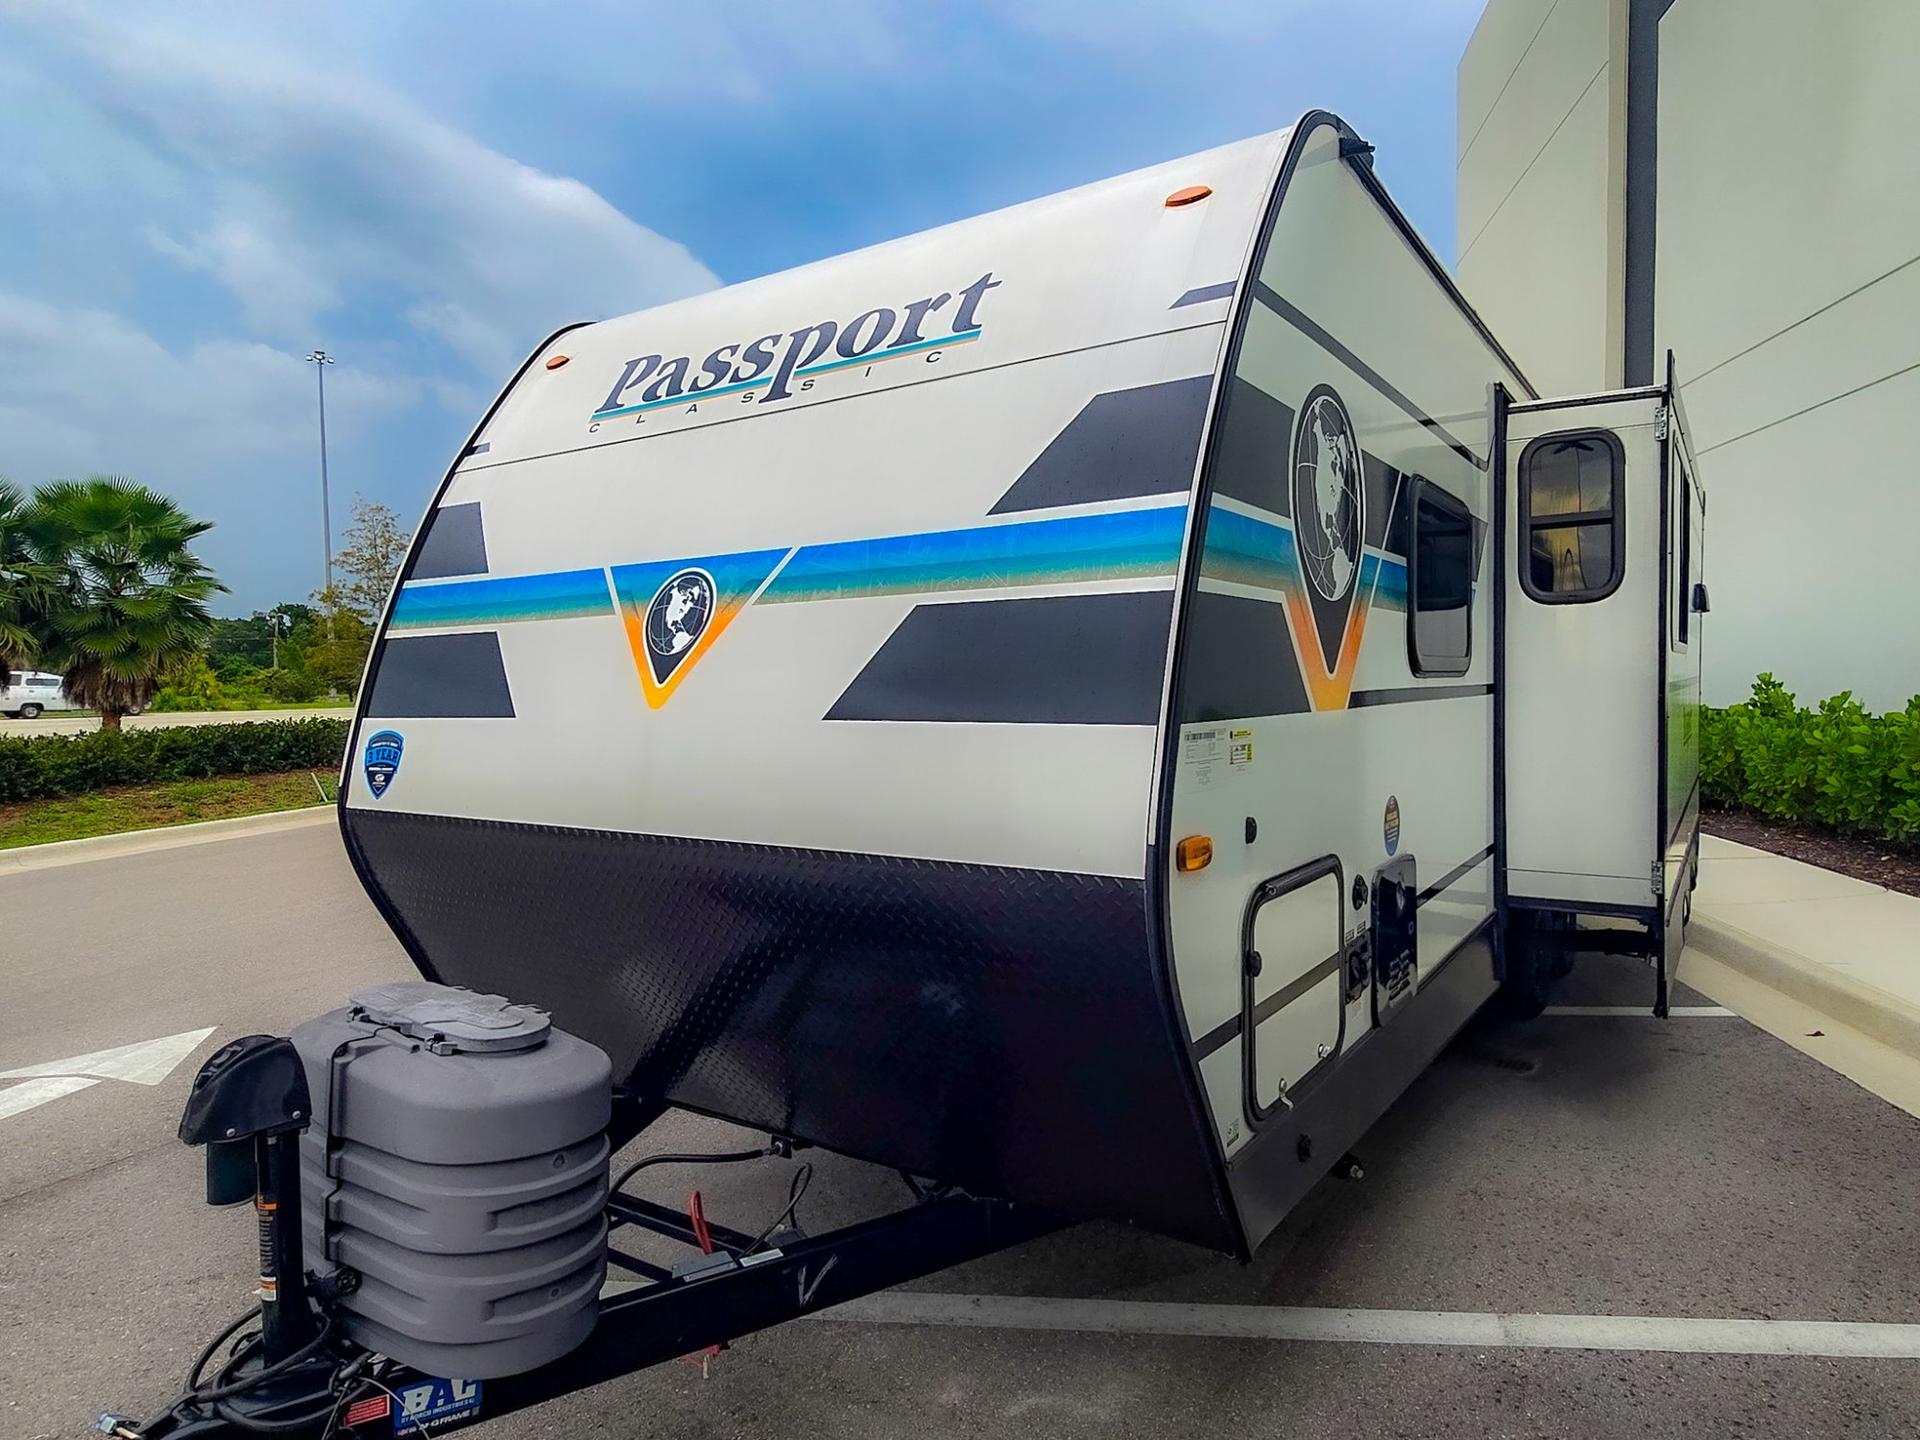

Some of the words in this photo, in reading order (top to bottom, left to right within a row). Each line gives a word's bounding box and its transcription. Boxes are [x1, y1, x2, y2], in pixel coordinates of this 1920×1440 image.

[595, 272, 1003, 414] Passport
[588, 350, 943, 433] CLASSIC
[375, 749, 398, 763] YEAR
